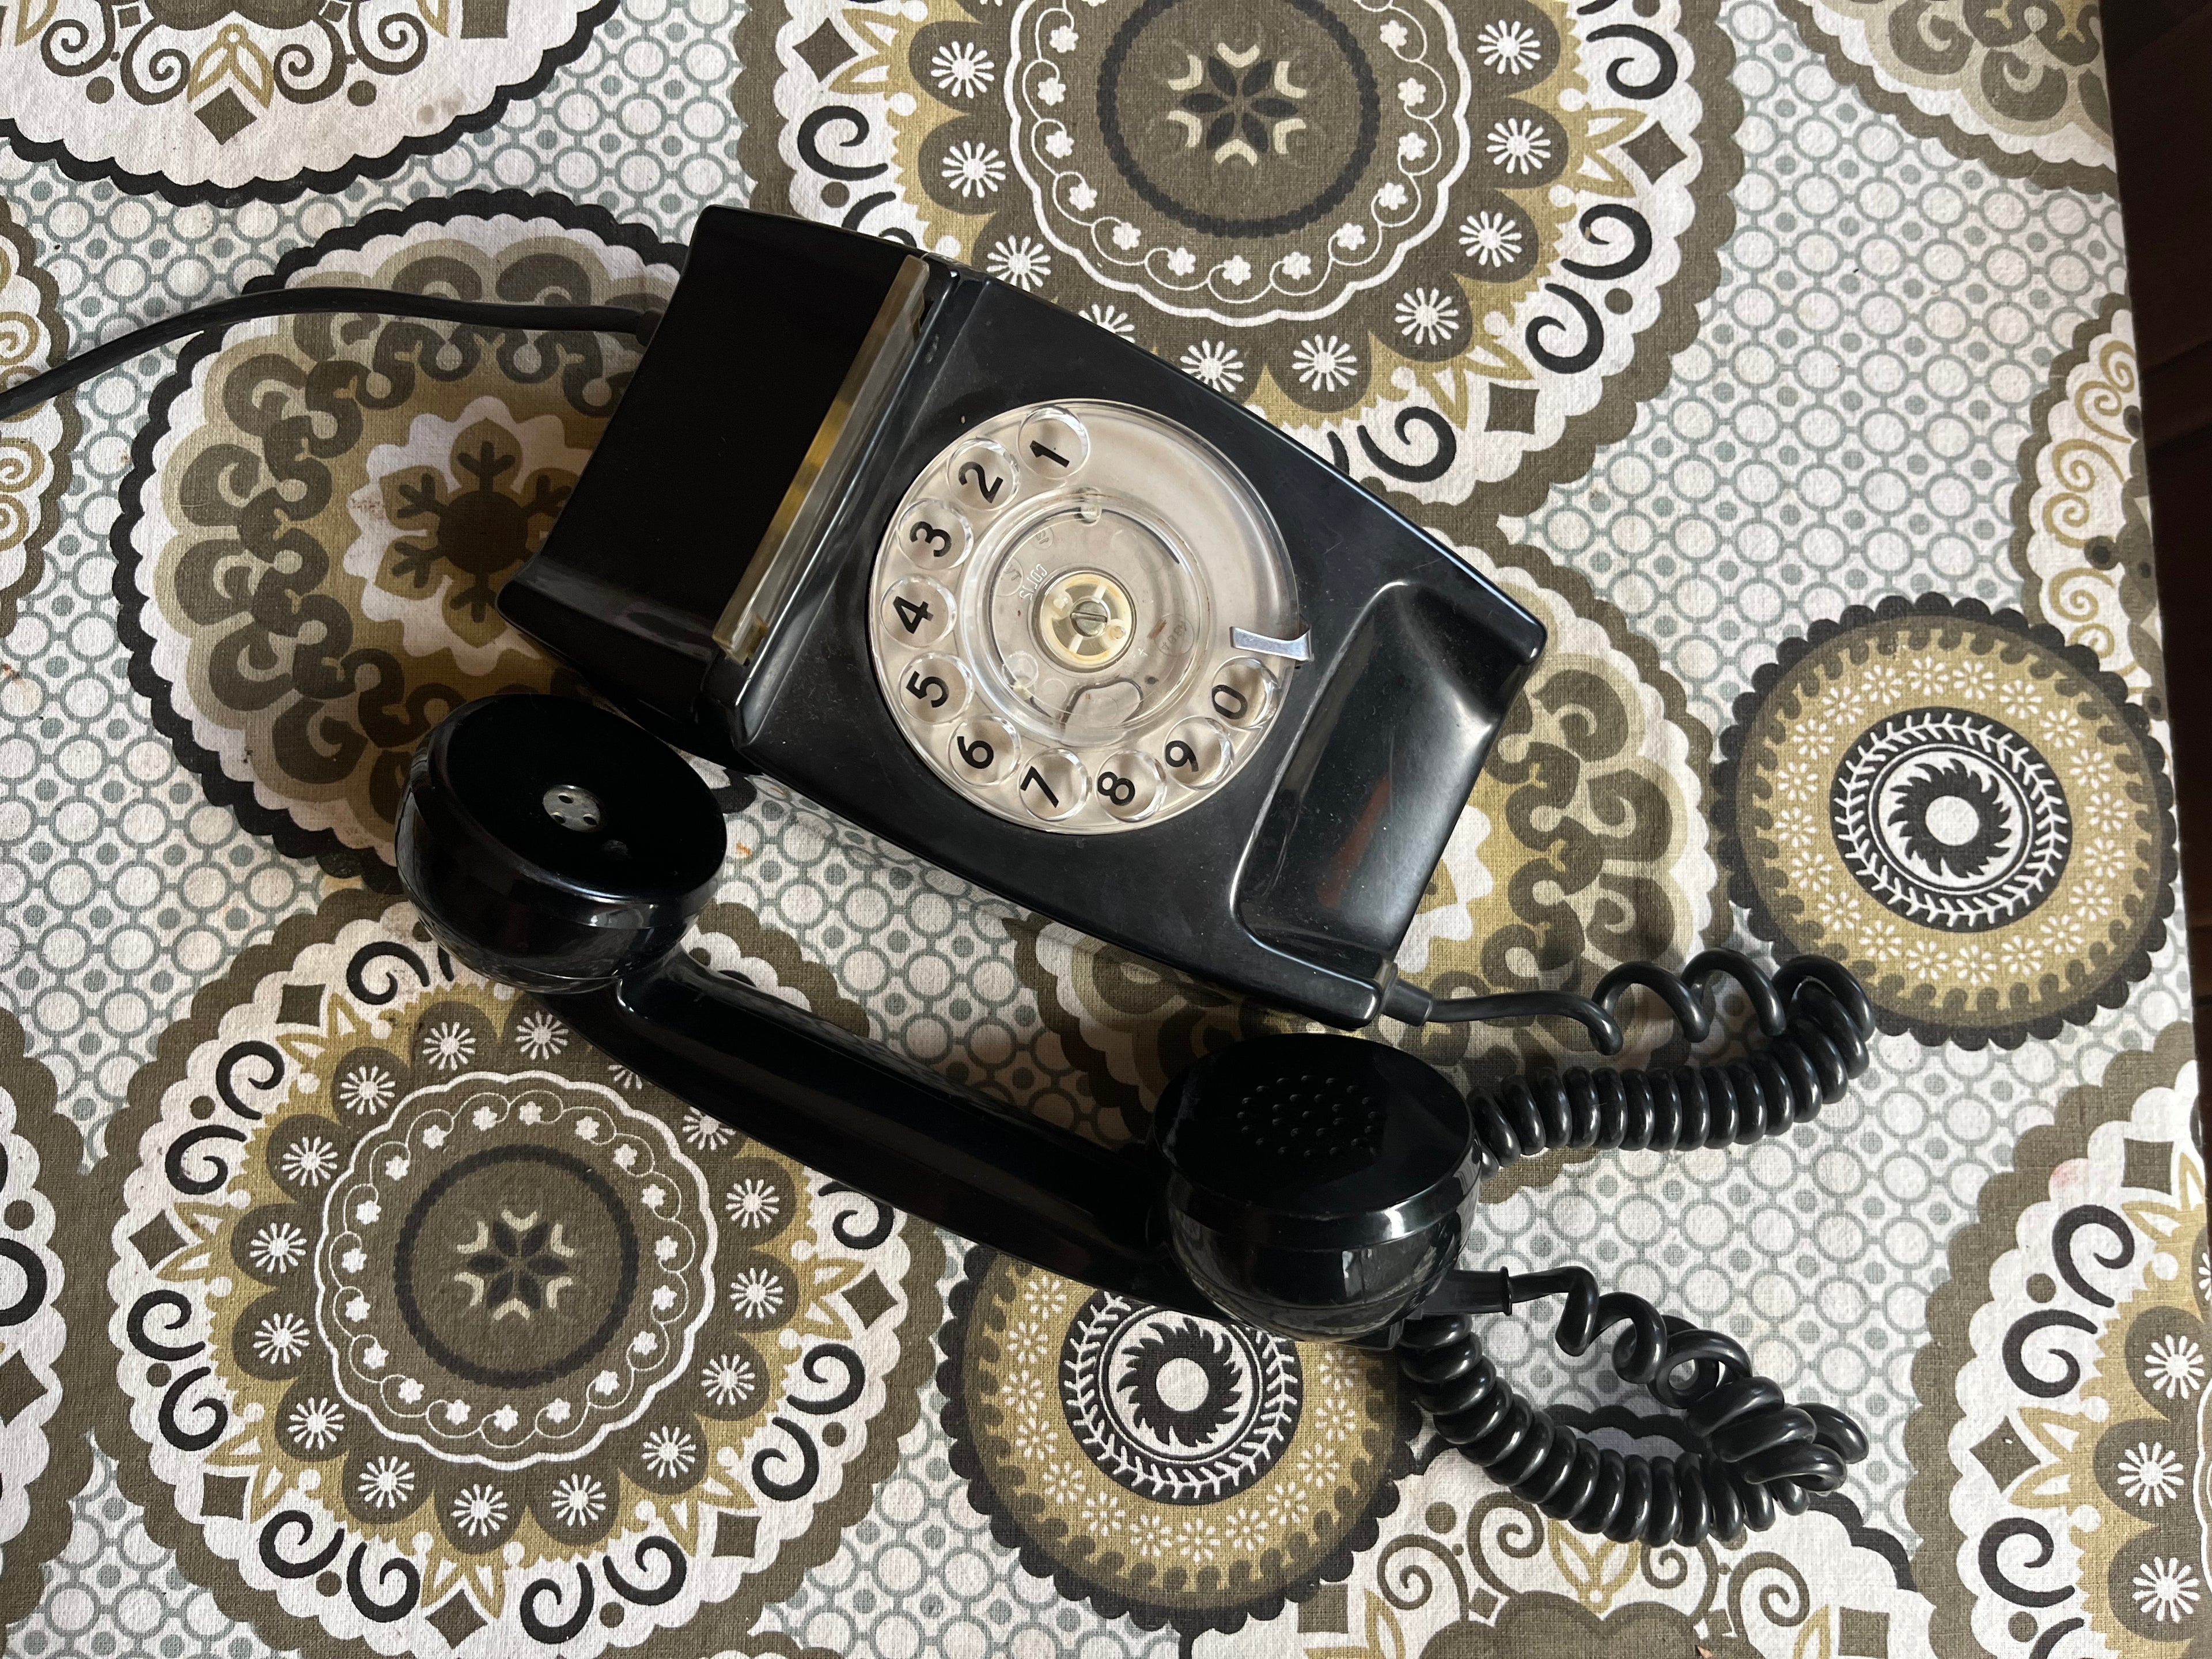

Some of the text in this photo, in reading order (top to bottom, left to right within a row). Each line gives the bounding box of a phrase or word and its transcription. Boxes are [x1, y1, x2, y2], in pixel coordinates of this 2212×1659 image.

[893, 440, 1248, 808] 1 2 3 4 5 6 7 8 9 0
